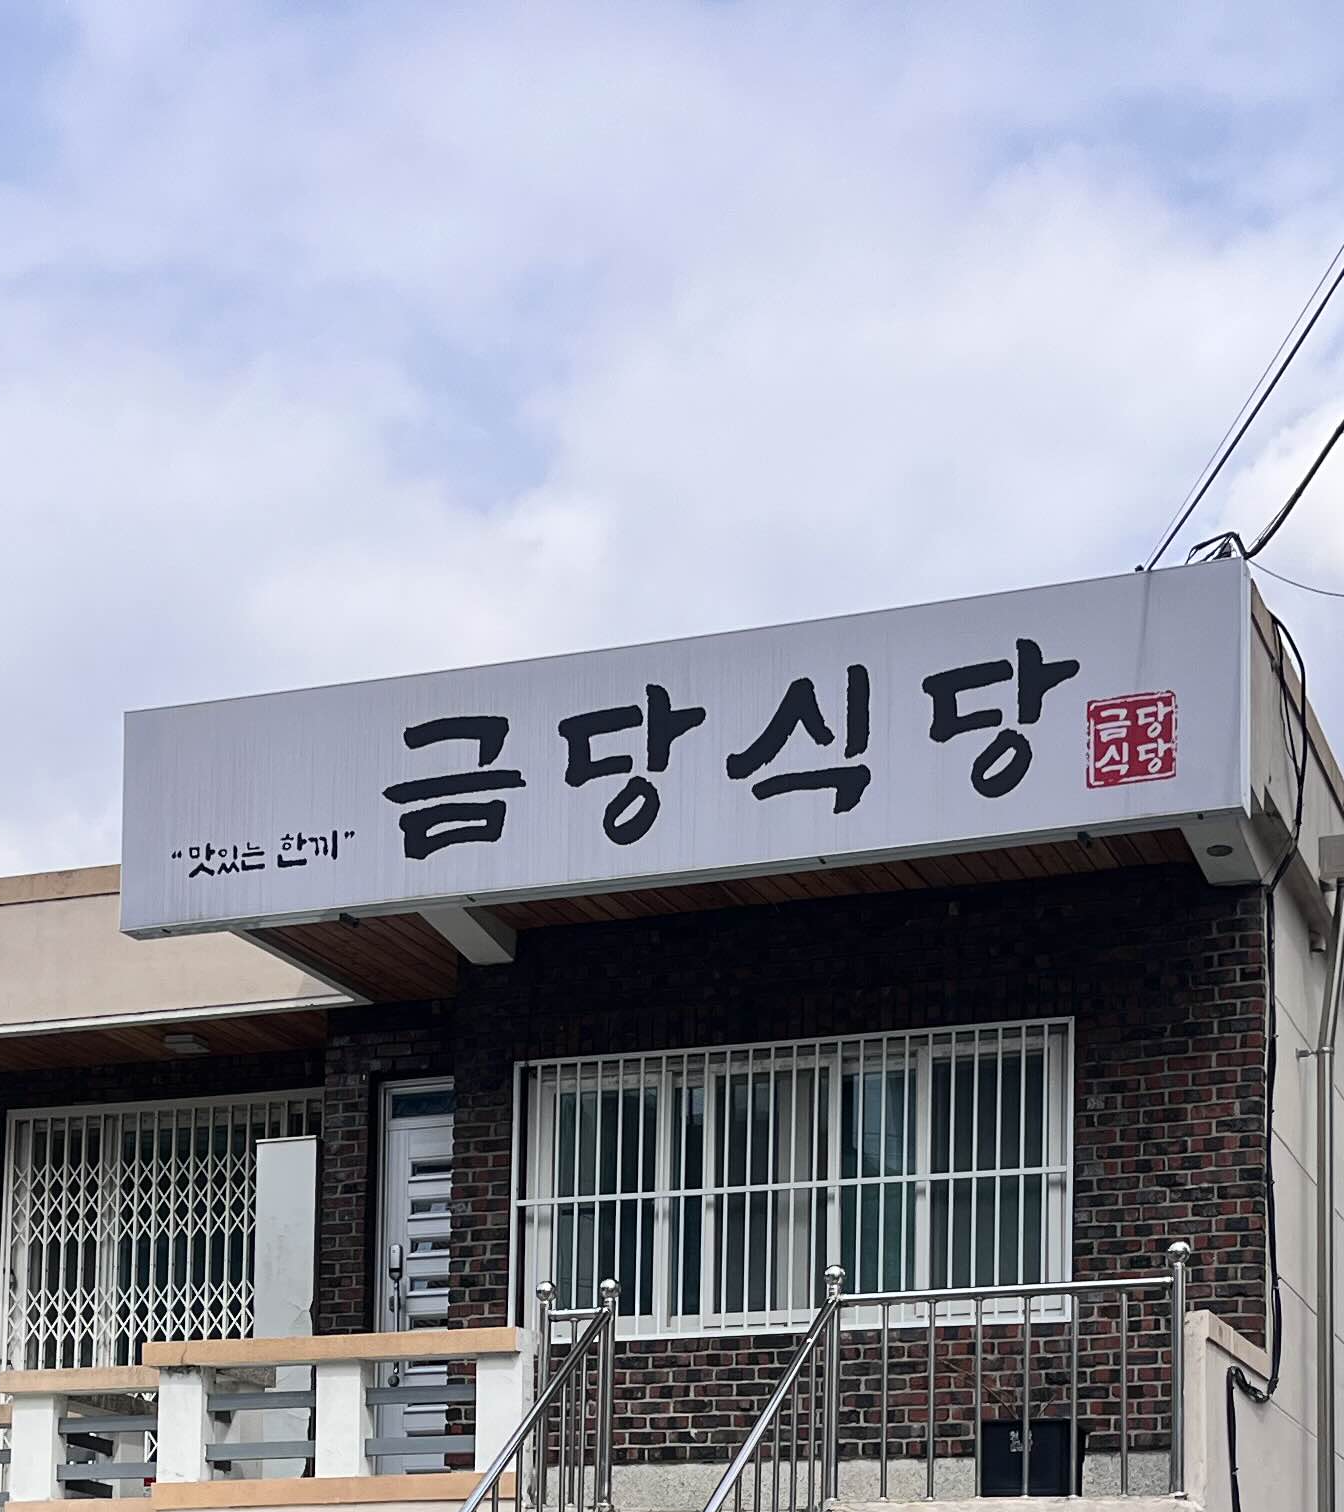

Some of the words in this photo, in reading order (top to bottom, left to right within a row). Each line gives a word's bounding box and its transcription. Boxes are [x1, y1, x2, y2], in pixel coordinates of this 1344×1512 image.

[1095, 701, 1175, 743] 금당
[381, 638, 1080, 860] 금당식당
[1094, 738, 1174, 775] 식당
